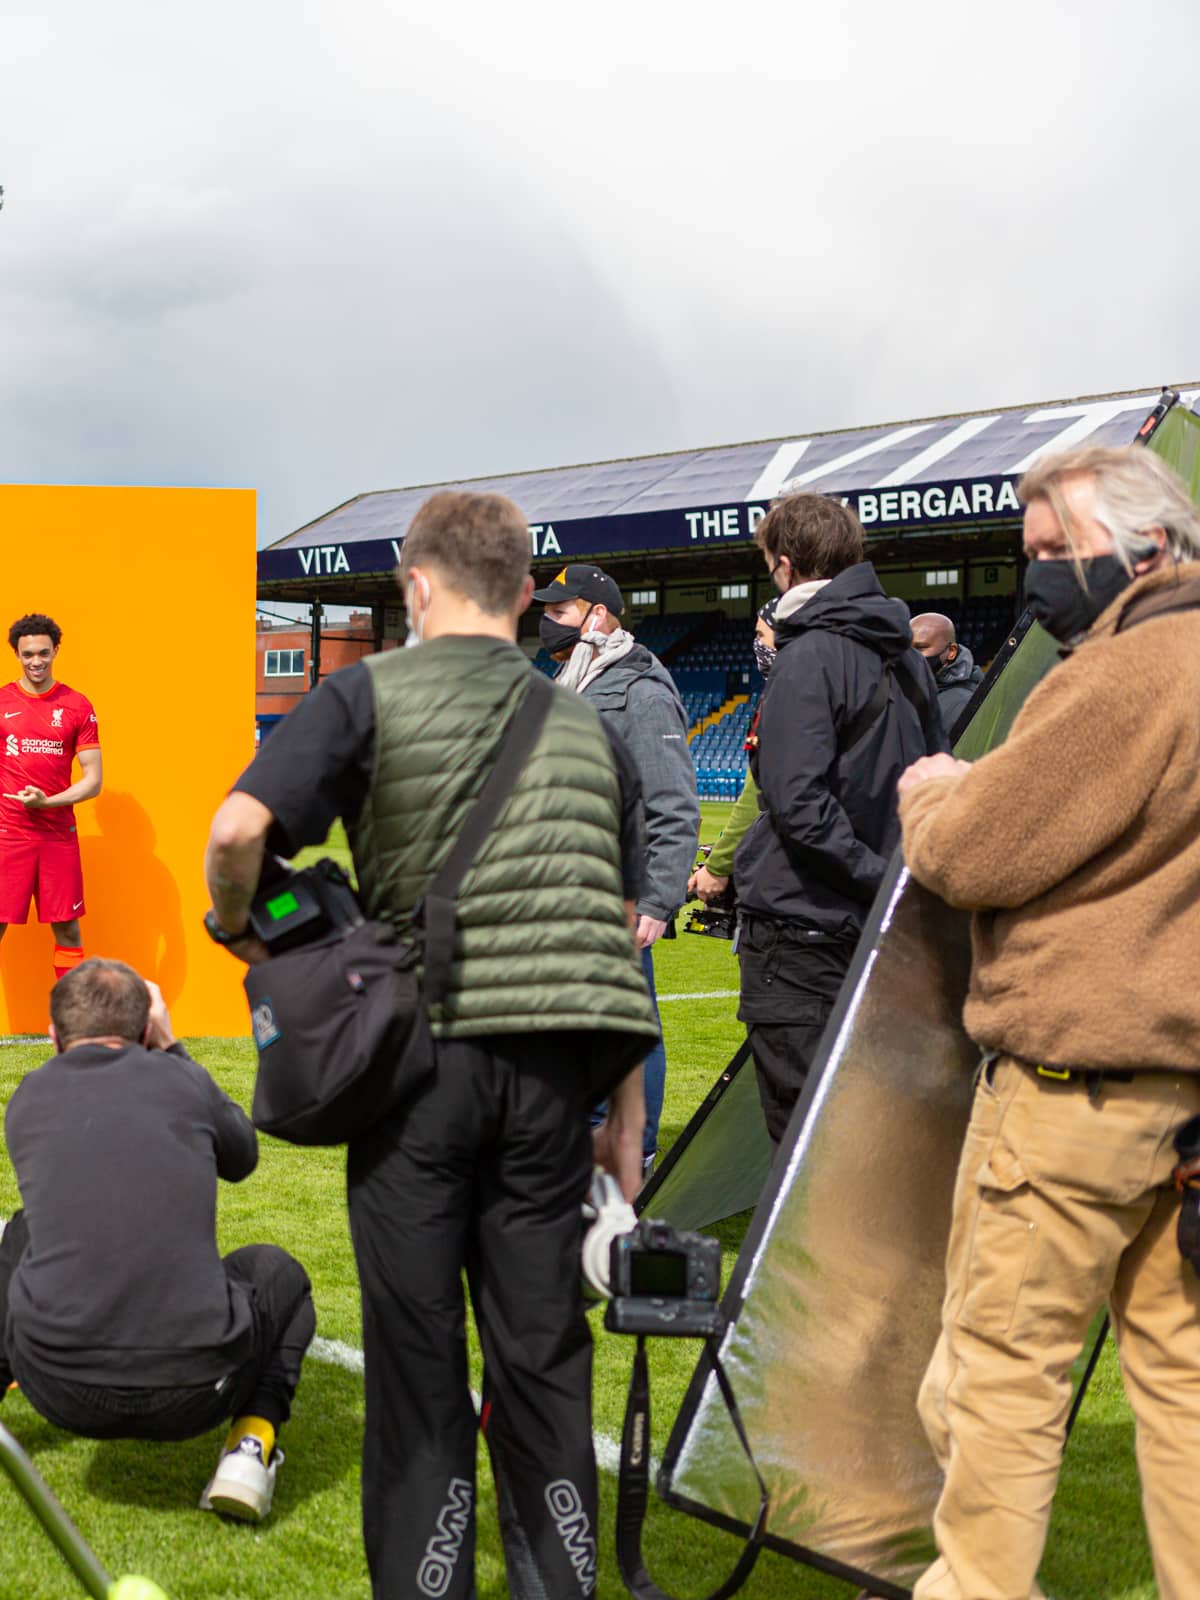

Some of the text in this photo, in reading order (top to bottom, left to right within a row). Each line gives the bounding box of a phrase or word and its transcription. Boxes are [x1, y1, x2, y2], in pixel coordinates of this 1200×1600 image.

[685, 508, 740, 540] THE
[858, 480, 1020, 524] BERGARA
[527, 524, 562, 556] TA
[298, 546, 351, 575] VITA
[21, 737, 63, 747] standard
[21, 745, 63, 755] chartered
[416, 1477, 472, 1598] OMM
